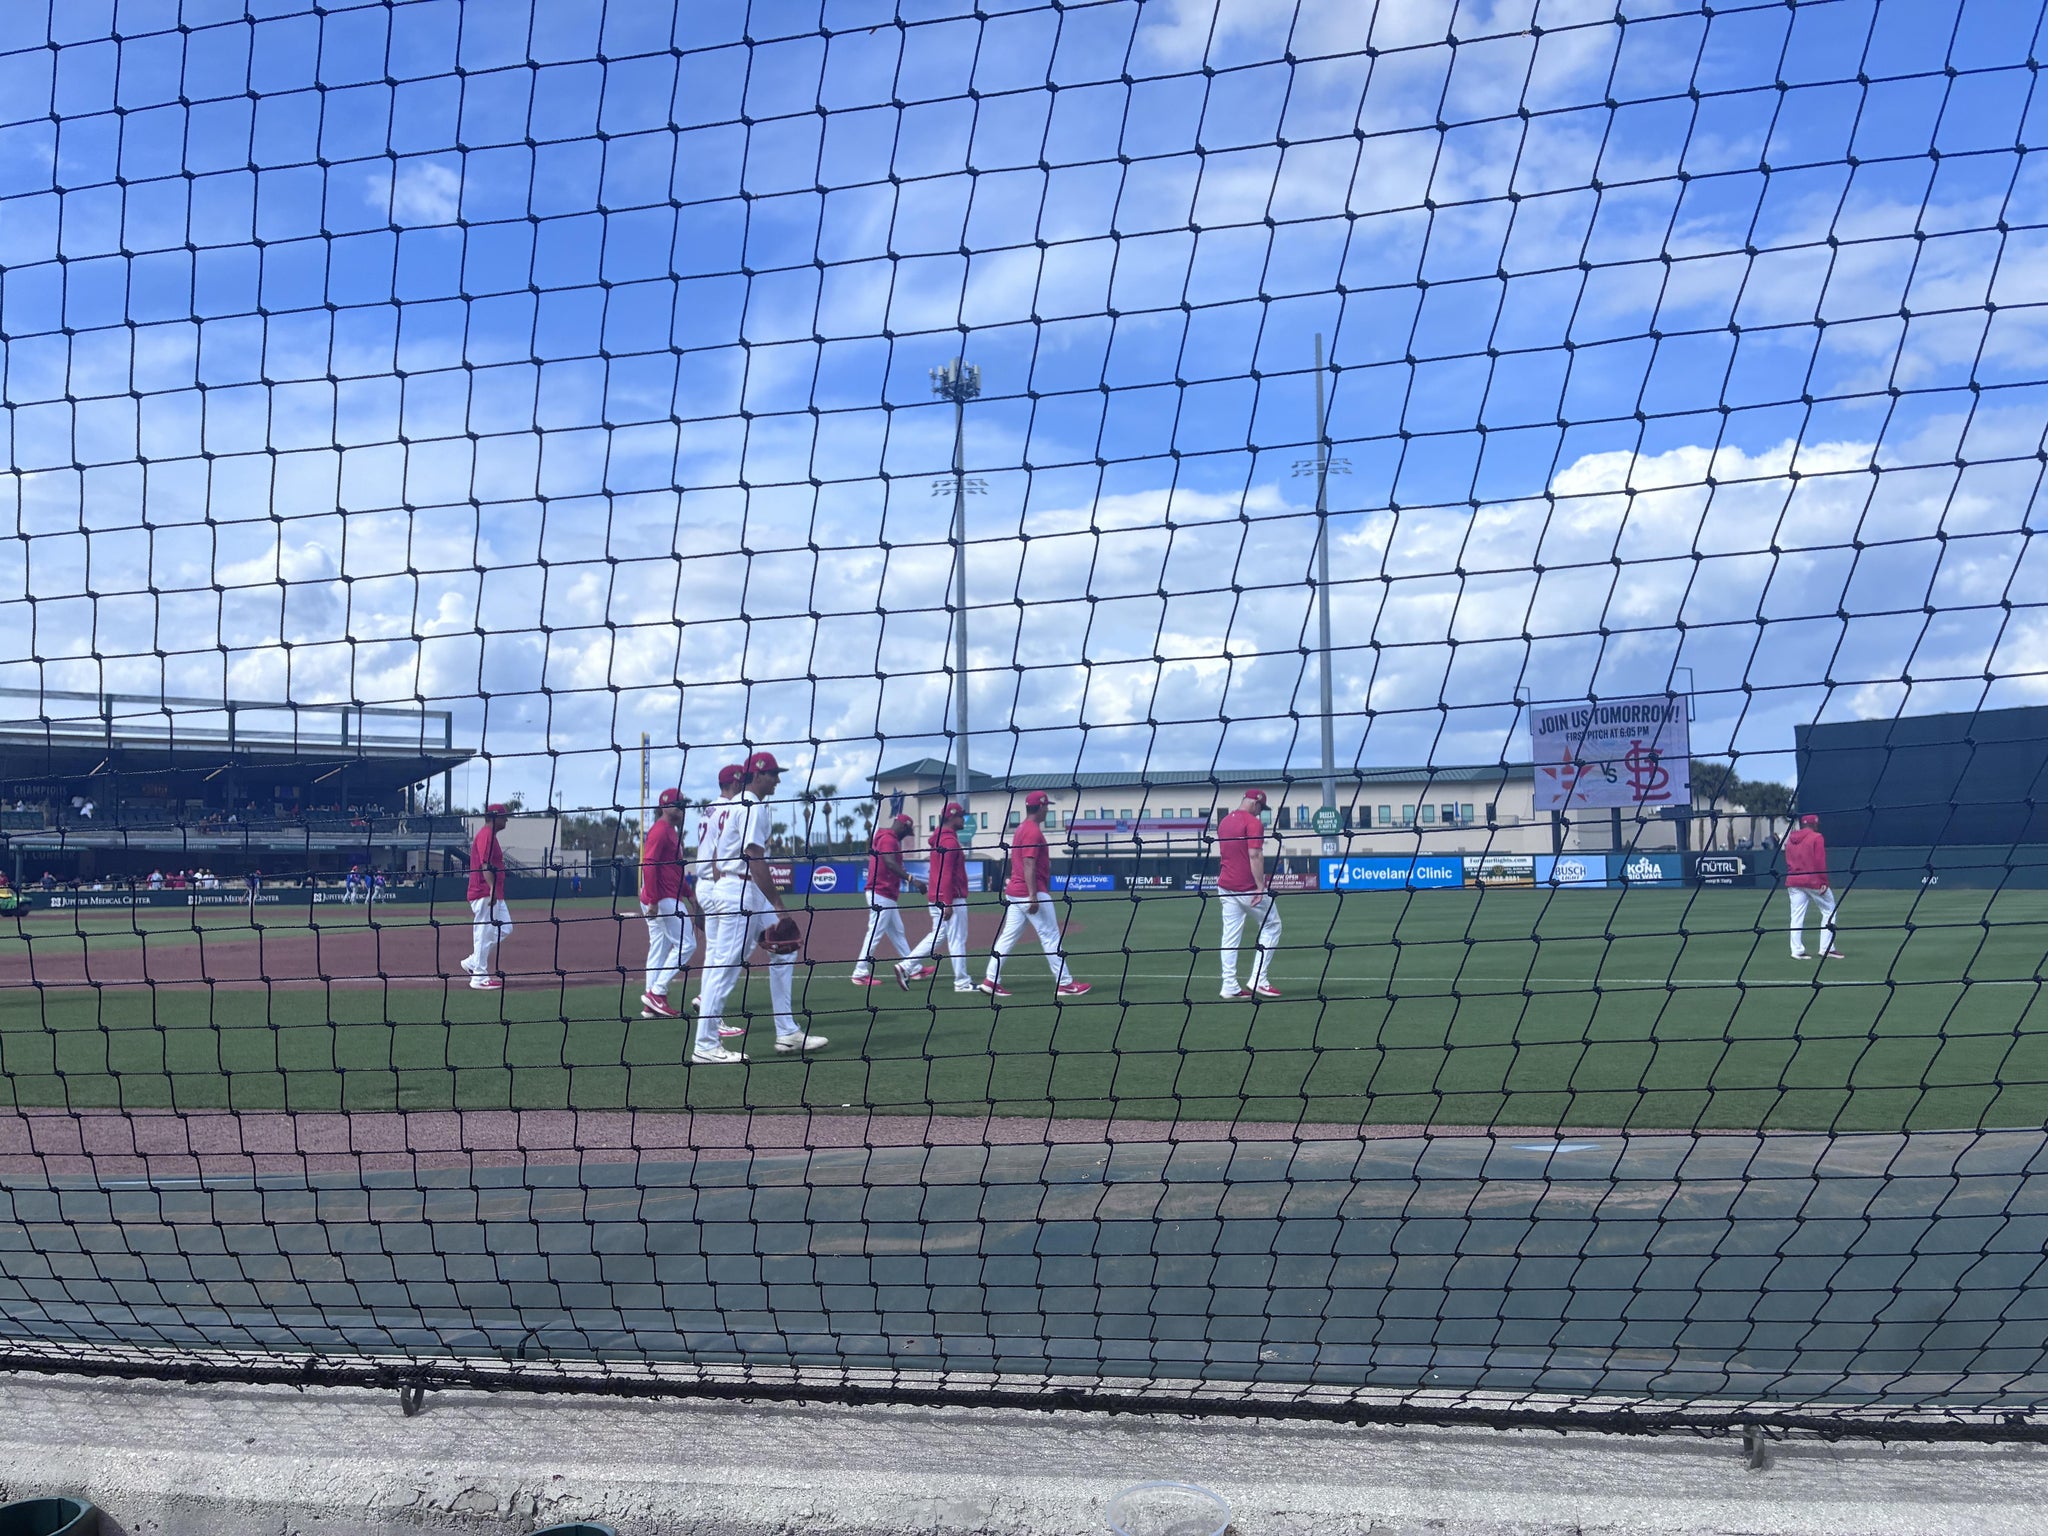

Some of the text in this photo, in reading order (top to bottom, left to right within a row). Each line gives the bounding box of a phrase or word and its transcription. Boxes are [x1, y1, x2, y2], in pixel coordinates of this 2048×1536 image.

[1539, 704, 1680, 735] JOIN US TOMORROW!
[1587, 729, 1609, 741] PITCH
[1610, 727, 1618, 739] AT
[1620, 727, 1636, 738] 6:05
[1637, 725, 1649, 737] PM
[1600, 761, 1618, 783] VS
[1352, 867, 1413, 880] Cleveland
[1417, 866, 1452, 879] Clinic
[1555, 866, 1587, 876] BUSCH
[1627, 863, 1662, 874] KONA
[1078, 876, 1092, 886] you
[61, 896, 89, 907] JUPTER
[90, 896, 122, 905] MEDICAL
[198, 895, 223, 905] JUPITER
